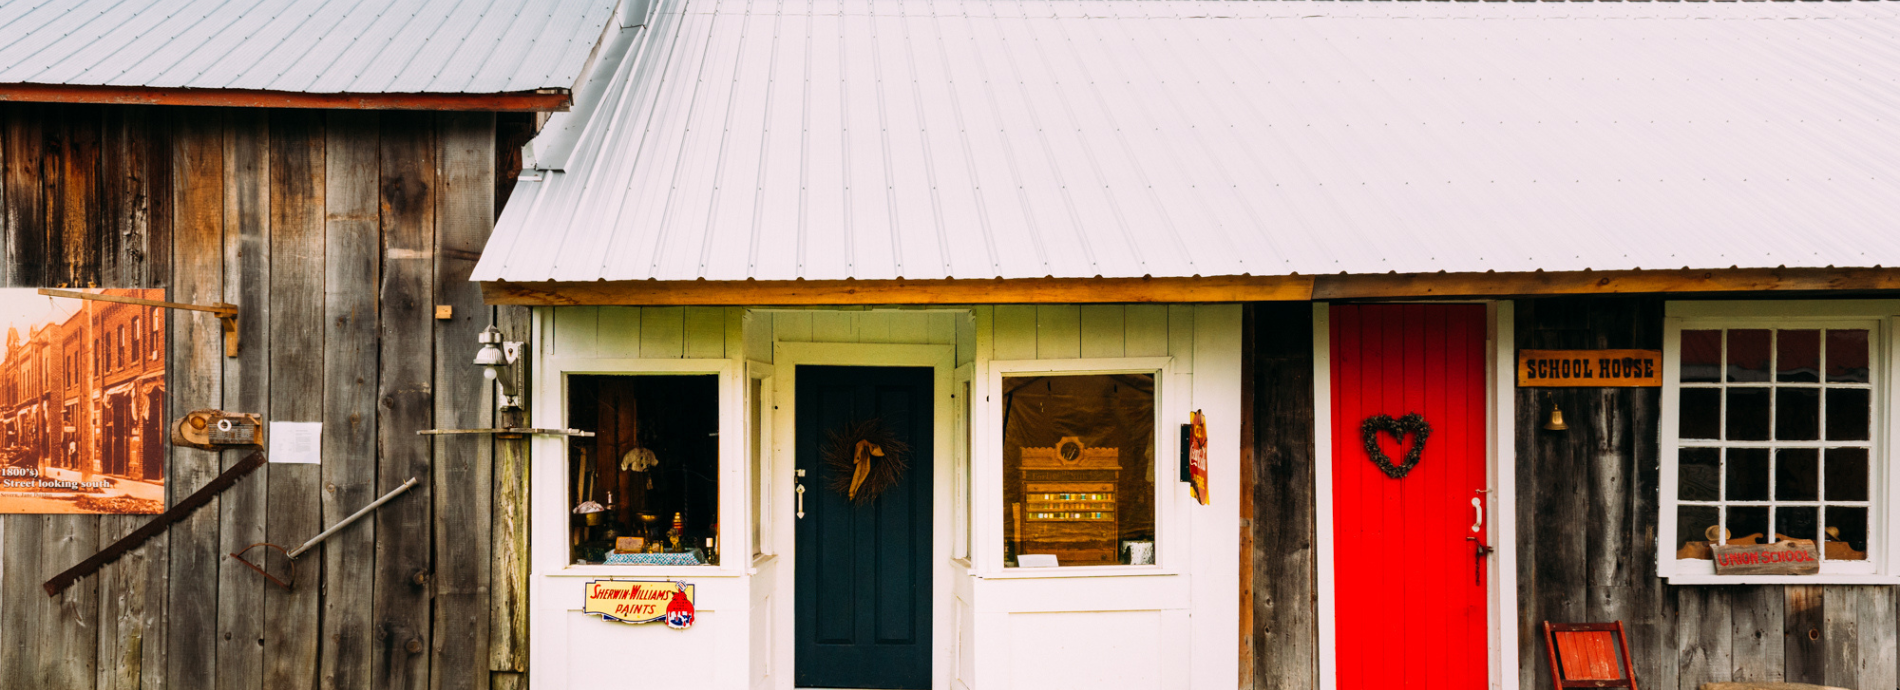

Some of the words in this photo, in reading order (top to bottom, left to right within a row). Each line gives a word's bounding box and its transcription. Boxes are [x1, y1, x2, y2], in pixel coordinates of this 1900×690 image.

[1527, 358, 1593, 379] SCHOOL
[1598, 357, 1654, 379] HOUSE
[3, 479, 36, 488] Street
[38, 479, 79, 490] looking
[81, 479, 110, 488] south
[1717, 551, 1759, 566] UNION
[1761, 550, 1815, 564] SCHOOL
[615, 604, 657, 614] PAINTS
